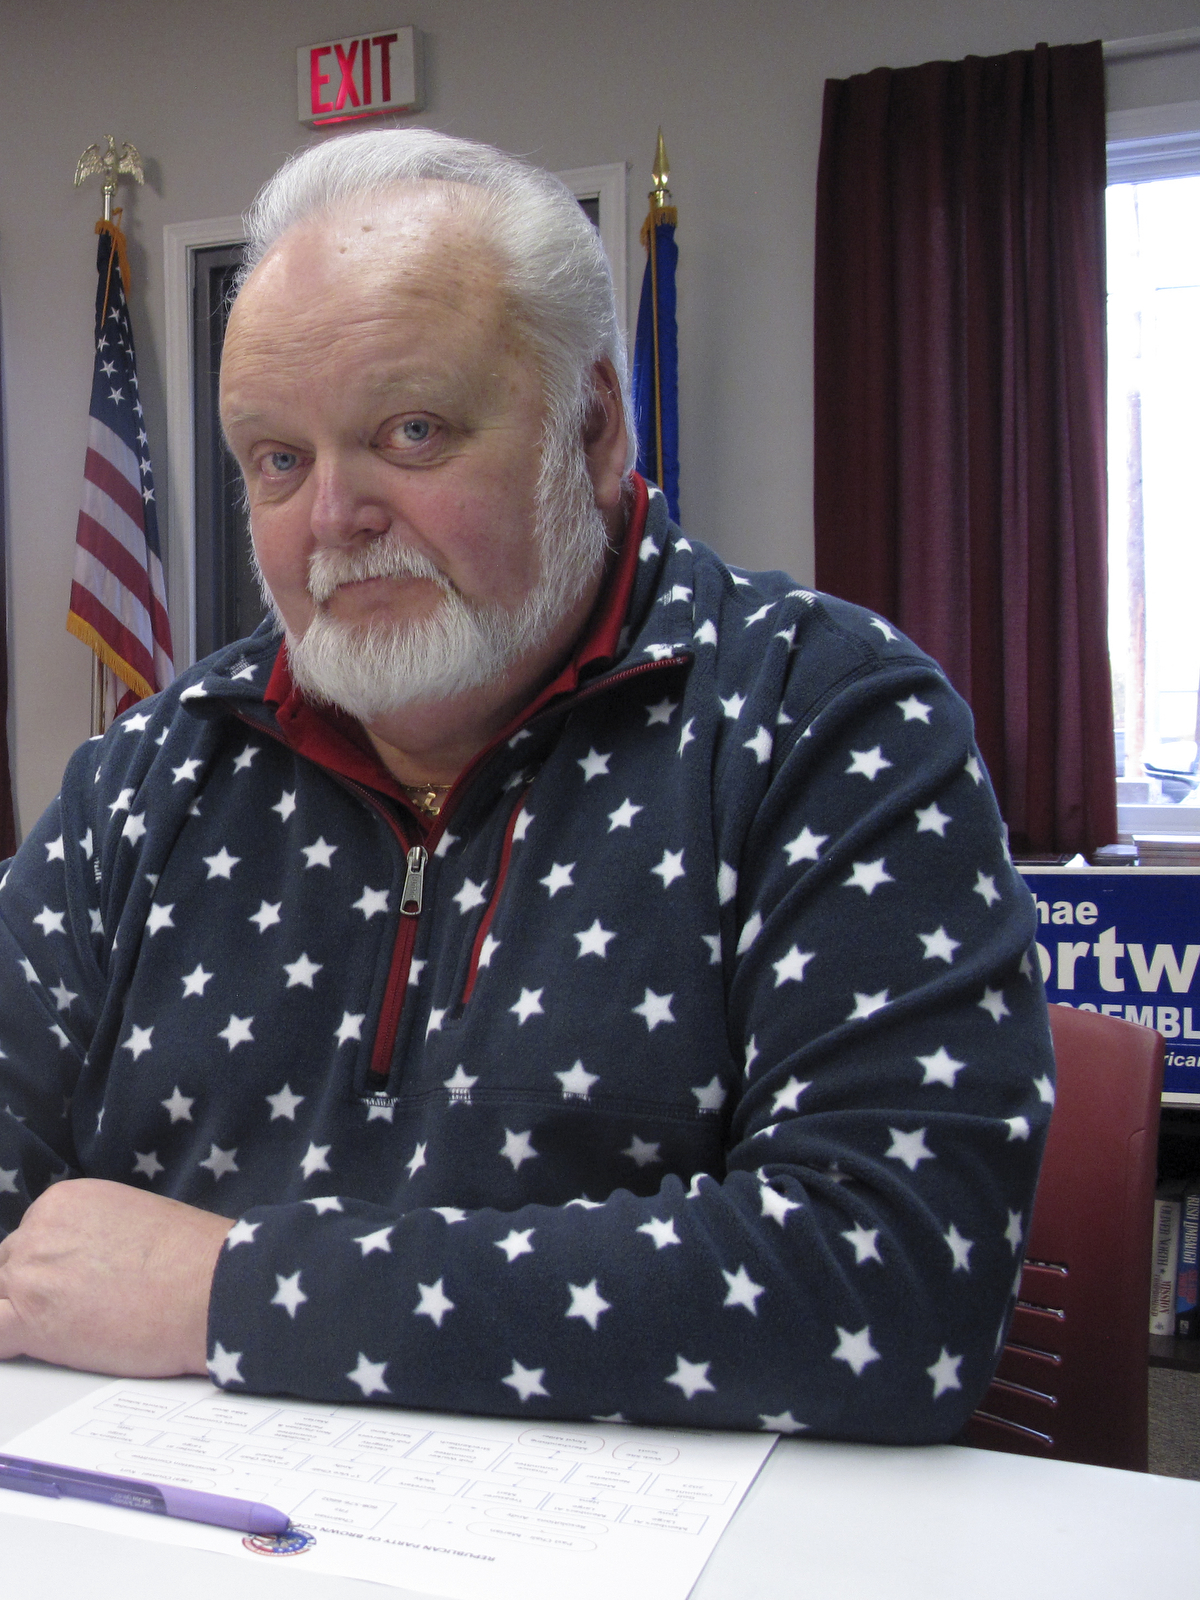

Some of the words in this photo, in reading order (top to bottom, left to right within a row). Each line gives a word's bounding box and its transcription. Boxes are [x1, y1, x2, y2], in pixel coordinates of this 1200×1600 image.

[310, 33, 398, 115] EXIT
[1160, 1205, 1172, 1236] OLIVER
[1186, 1196, 1199, 1220] RUSH
[1157, 1238, 1171, 1266] NORTH
[1182, 1220, 1199, 1264] LIMBAUGH
[1159, 1281, 1172, 1314] MISSION
[318, 1526, 364, 1538] BROWN
[381, 1538, 421, 1548] PARTY
[421, 1544, 496, 1561] REPUBLICAN
